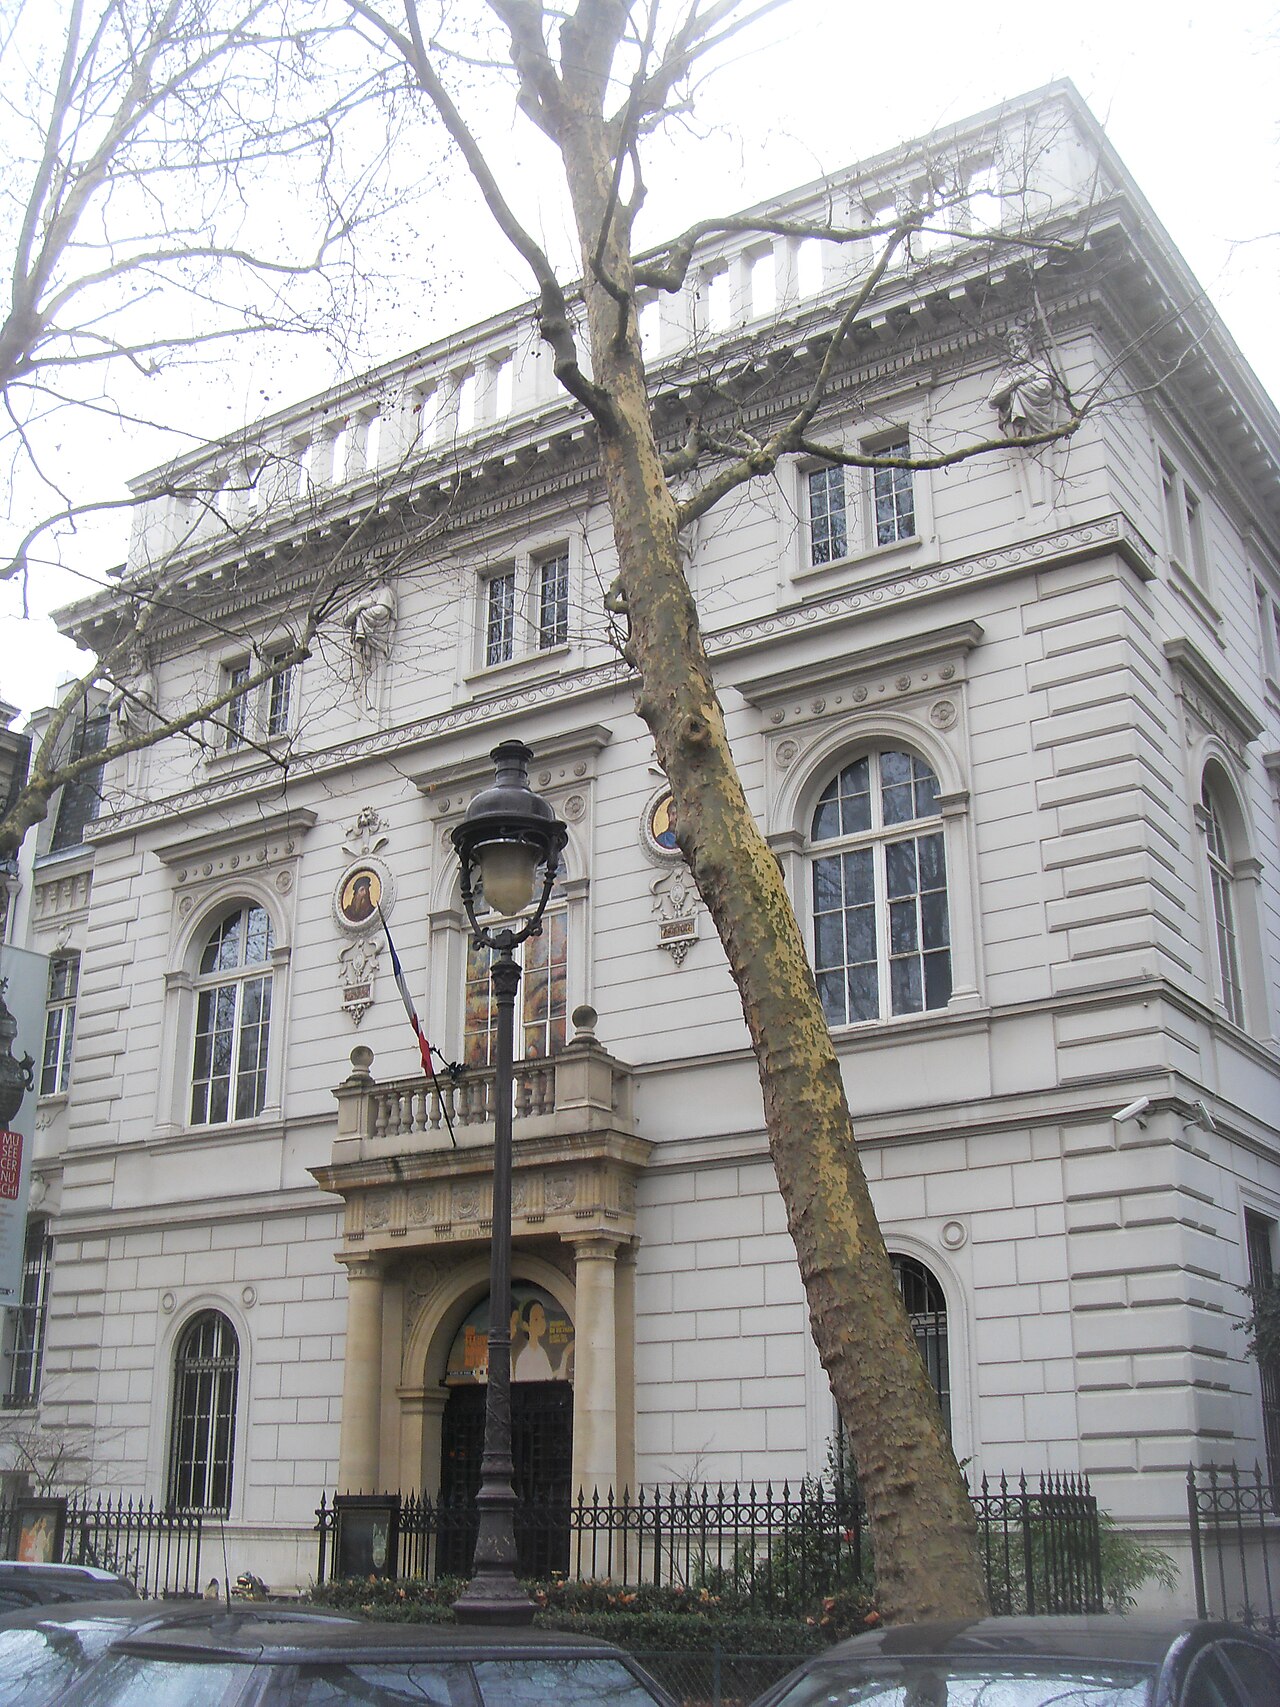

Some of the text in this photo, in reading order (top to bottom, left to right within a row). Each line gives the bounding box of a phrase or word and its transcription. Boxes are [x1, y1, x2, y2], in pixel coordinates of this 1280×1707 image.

[2, 1132, 20, 1146] MU
[0, 1157, 17, 1172] CER
[1, 1170, 15, 1183] NU
[0, 1183, 17, 1197] CHI
